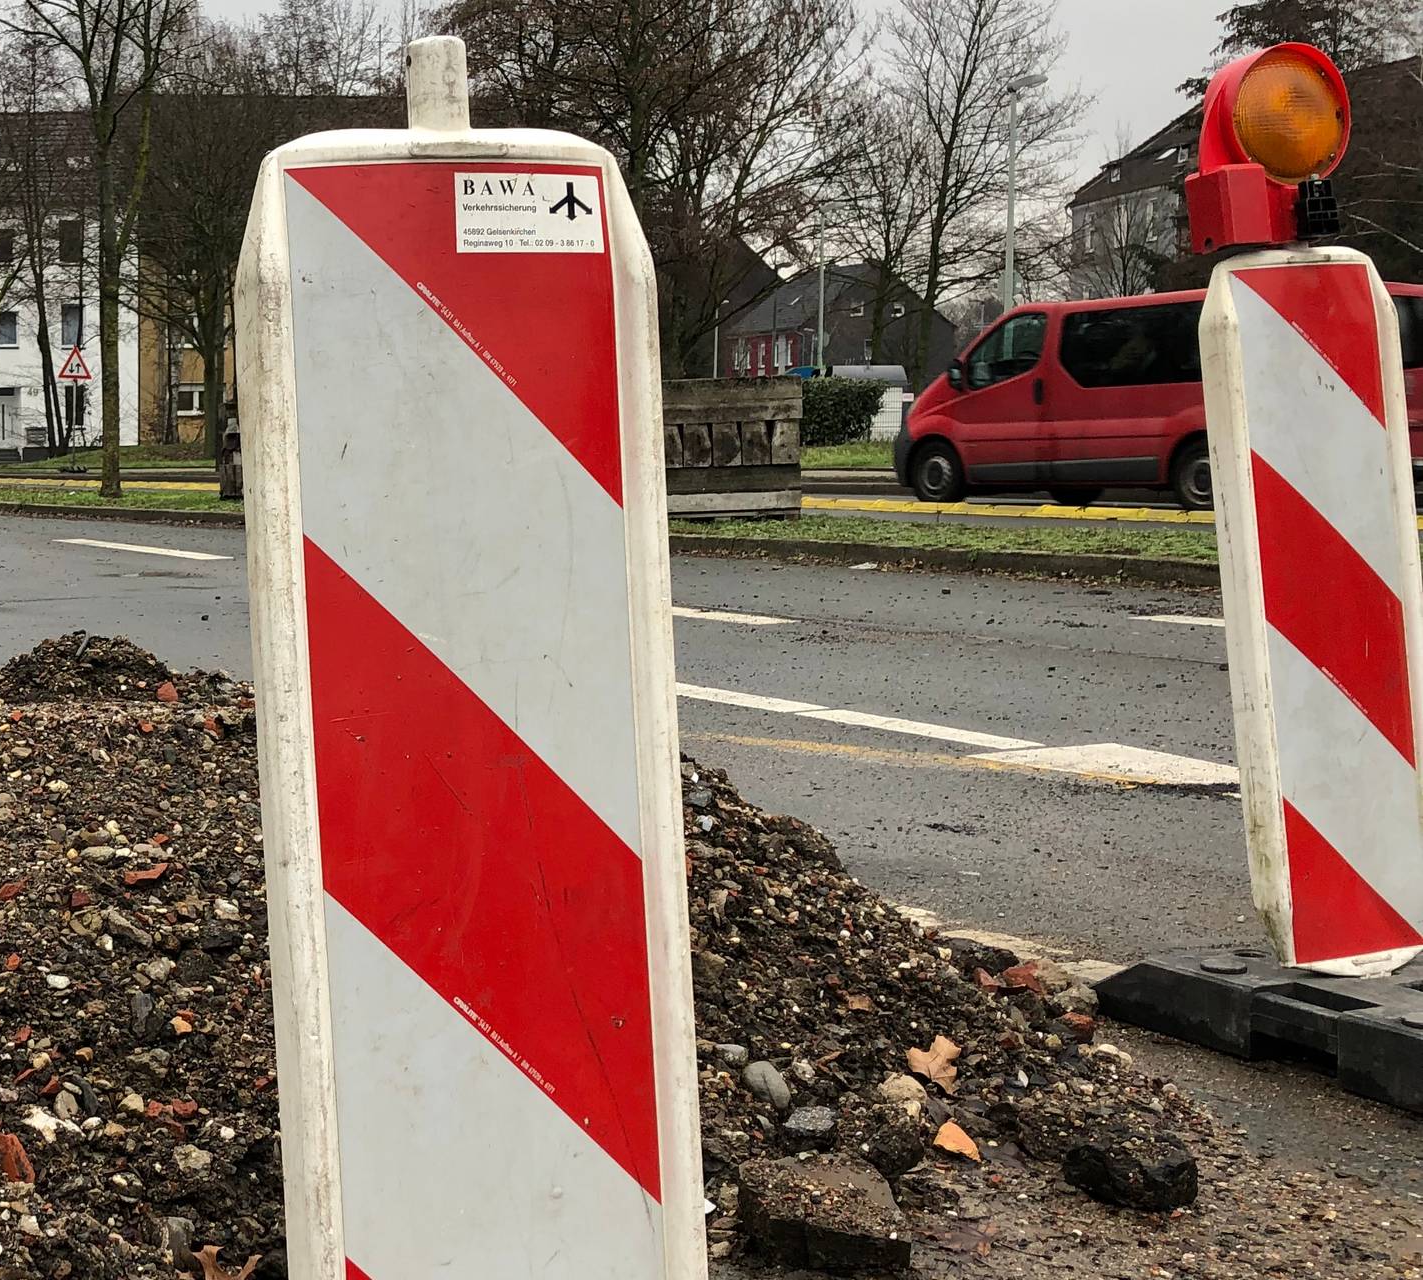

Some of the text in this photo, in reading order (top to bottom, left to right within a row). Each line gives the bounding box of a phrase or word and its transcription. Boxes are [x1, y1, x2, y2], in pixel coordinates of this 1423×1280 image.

[464, 178, 534, 195] BAWA
[463, 204, 536, 213] Verkehrssicherung
[464, 240, 503, 248] Reginaweg
[27, 388, 38, 396] 49
